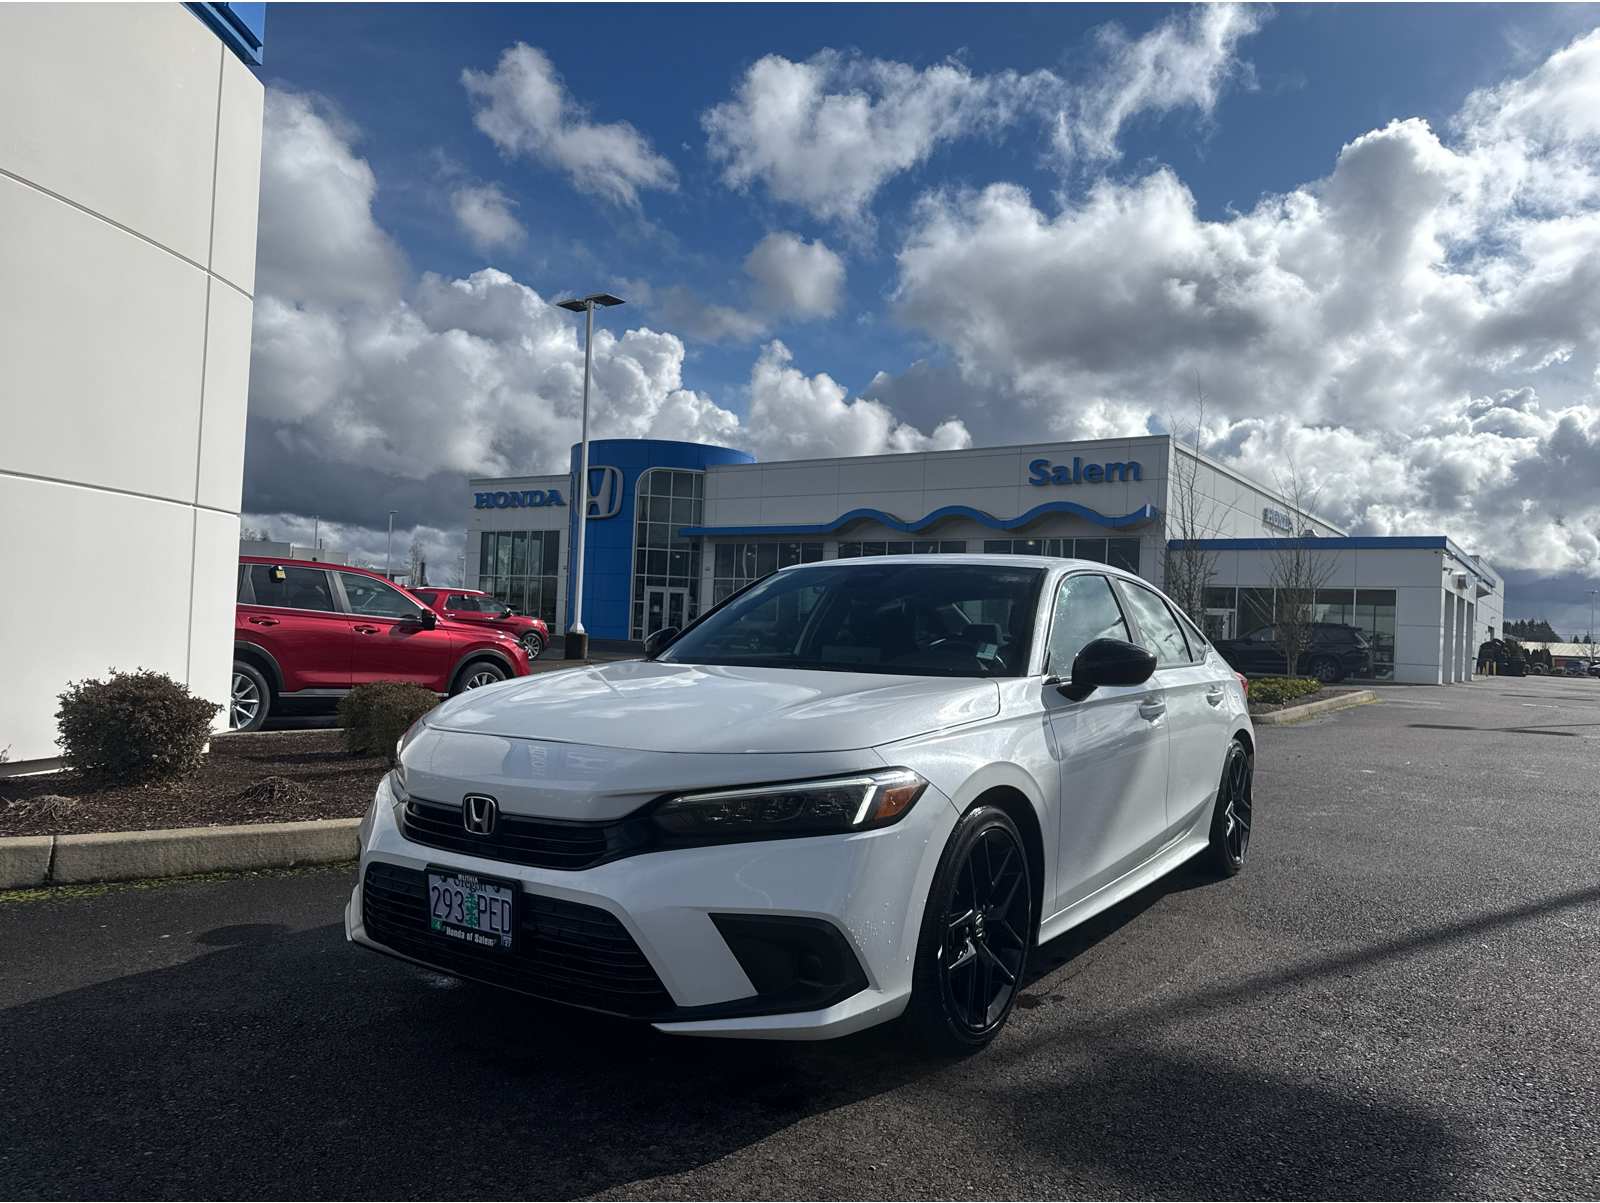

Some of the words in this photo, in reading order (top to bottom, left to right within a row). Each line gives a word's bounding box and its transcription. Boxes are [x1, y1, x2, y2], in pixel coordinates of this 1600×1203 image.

[1028, 456, 1143, 487] Salem
[474, 489, 566, 509] HONDA
[432, 886, 465, 922] 293
[478, 895, 512, 934] PED
[446, 926, 465, 939] Honda
[466, 932, 473, 941] of
